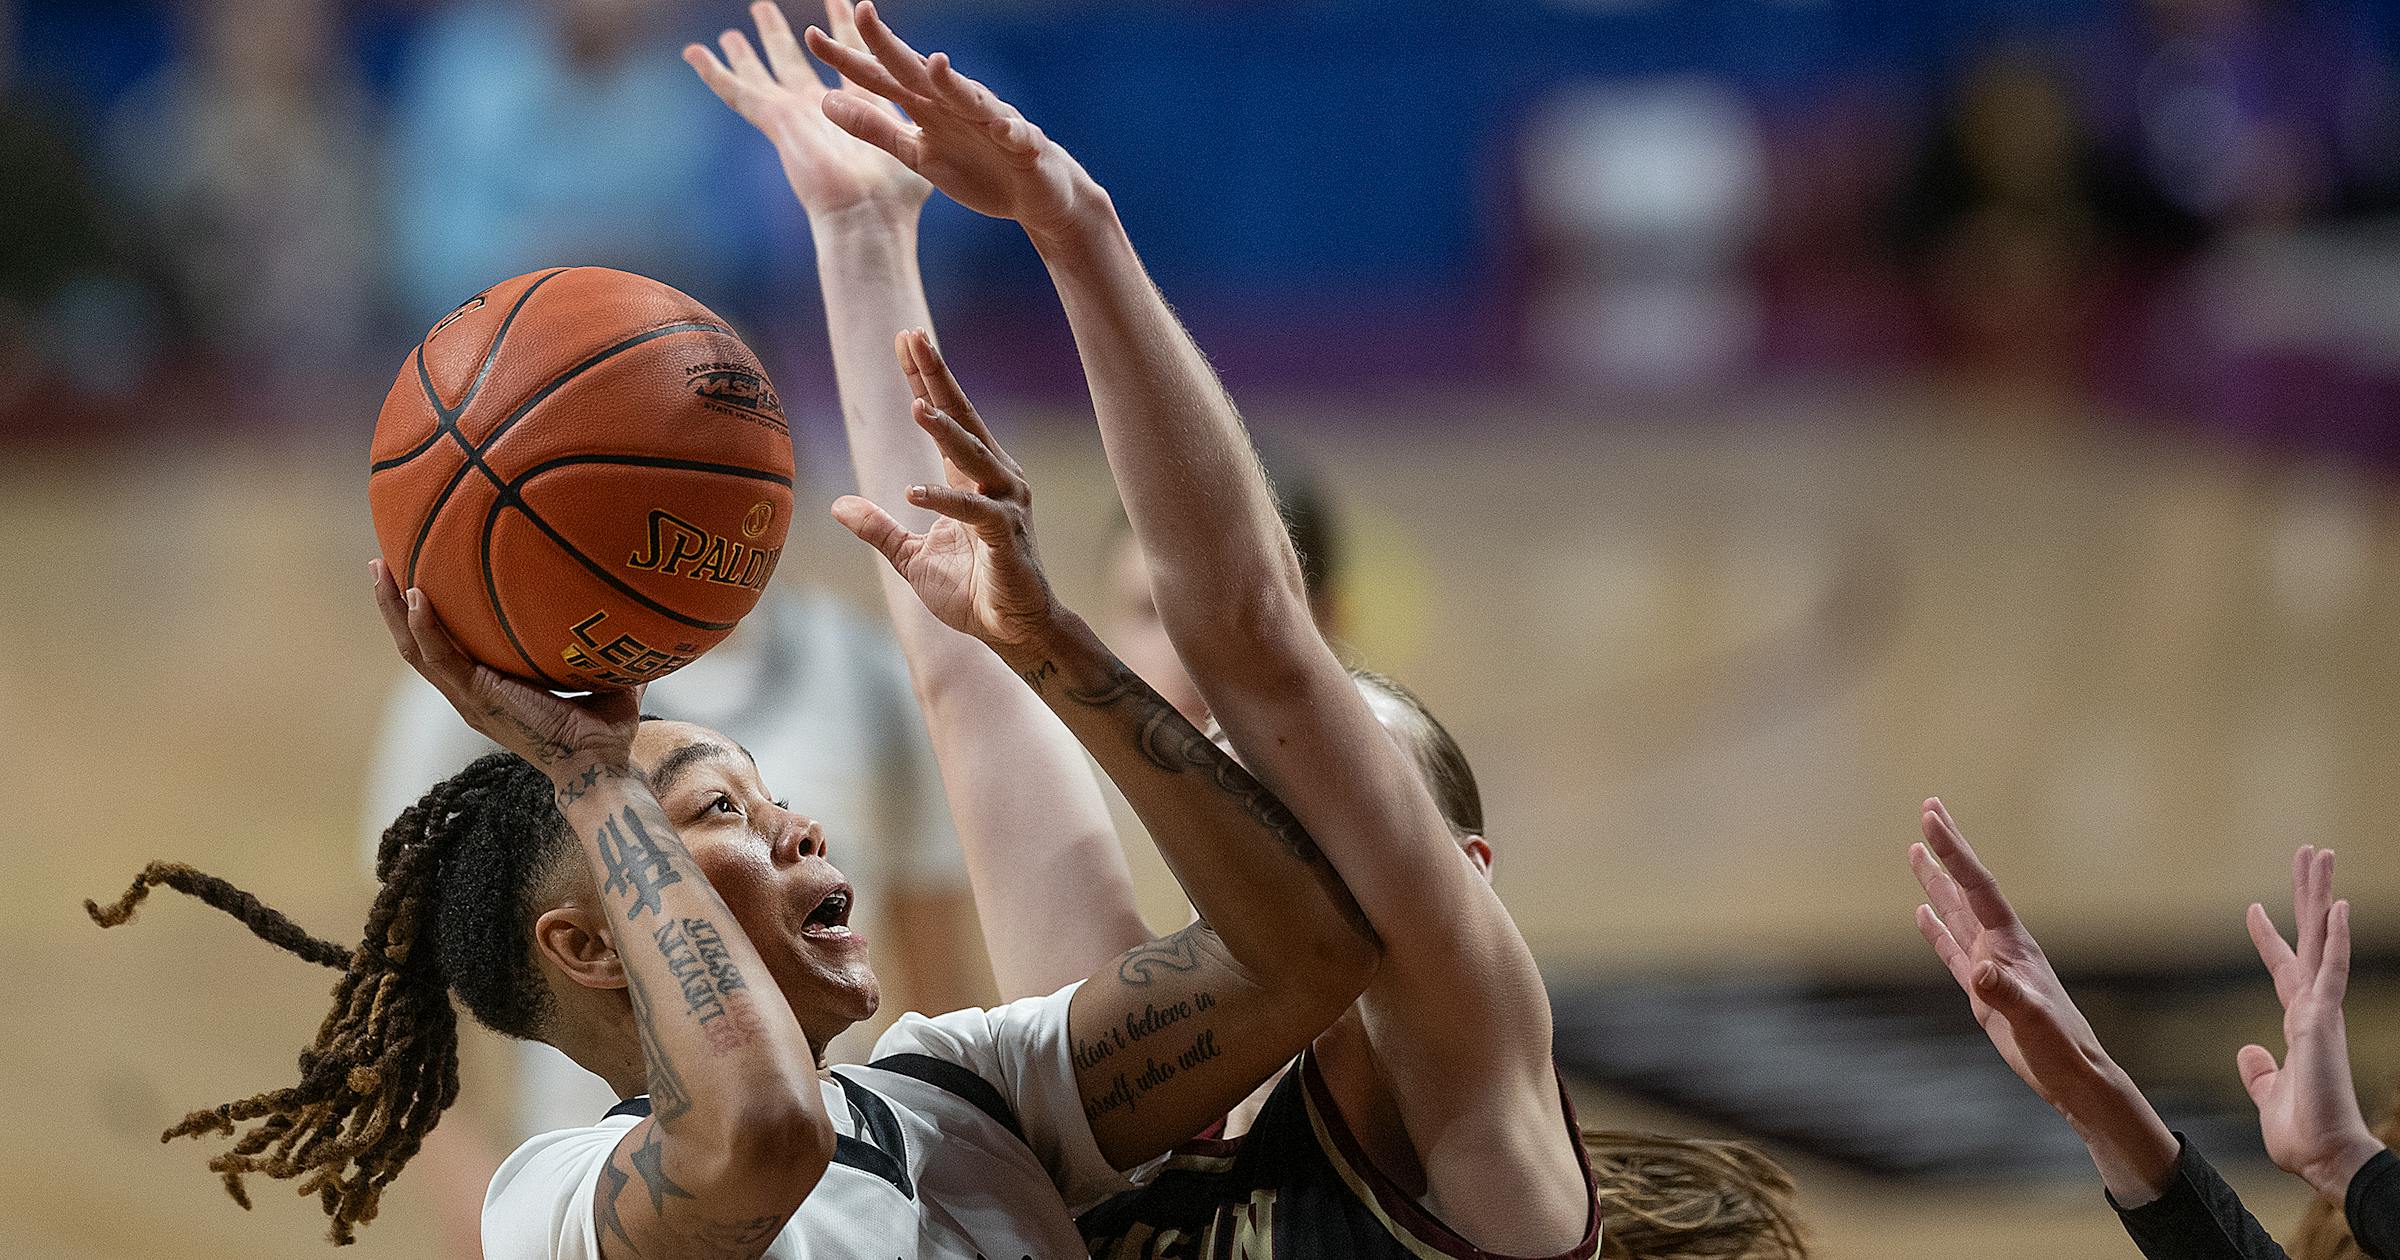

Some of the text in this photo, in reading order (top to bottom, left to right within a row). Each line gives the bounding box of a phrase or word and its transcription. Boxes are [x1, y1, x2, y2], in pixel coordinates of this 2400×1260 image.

[1126, 1003, 1192, 1042] believe
[1194, 991, 1216, 1012] in
[1136, 1056, 1176, 1092] who
[1178, 1028, 1221, 1071] will
